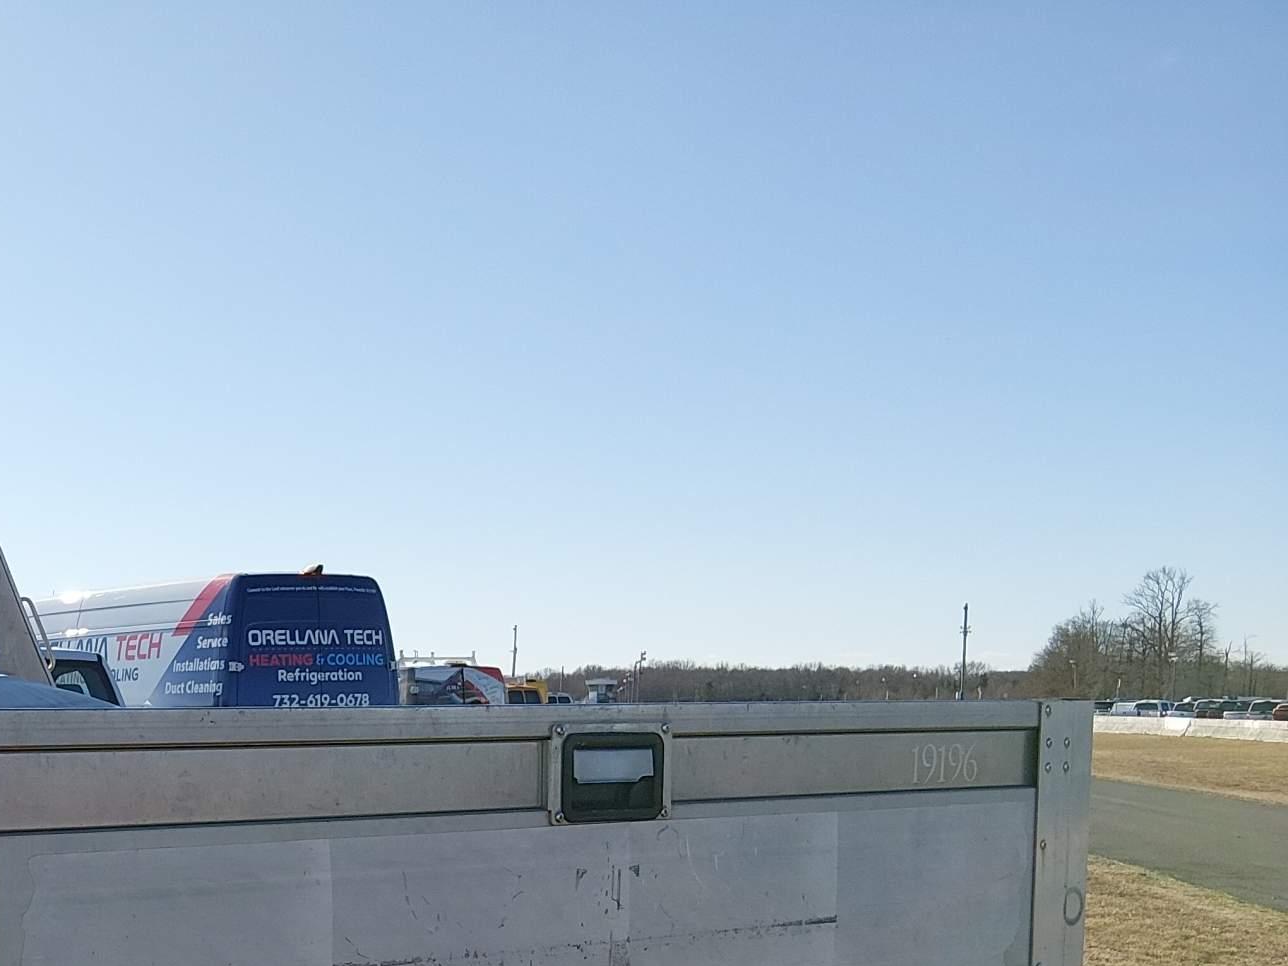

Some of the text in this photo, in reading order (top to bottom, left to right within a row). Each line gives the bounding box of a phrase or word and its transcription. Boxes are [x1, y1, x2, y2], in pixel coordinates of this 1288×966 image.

[207, 611, 233, 626] Sales
[196, 635, 229, 649] Service
[248, 629, 383, 646] ORELLANA TECH
[115, 632, 163, 662] TECH
[172, 656, 226, 673] Installations
[249, 653, 384, 667] HEATING & COOLING
[277, 668, 363, 685] Refrigeration
[165, 679, 223, 696] Duct Cleaning
[272, 693, 370, 707] 732-619-0678
[911, 742, 978, 785] 19196
